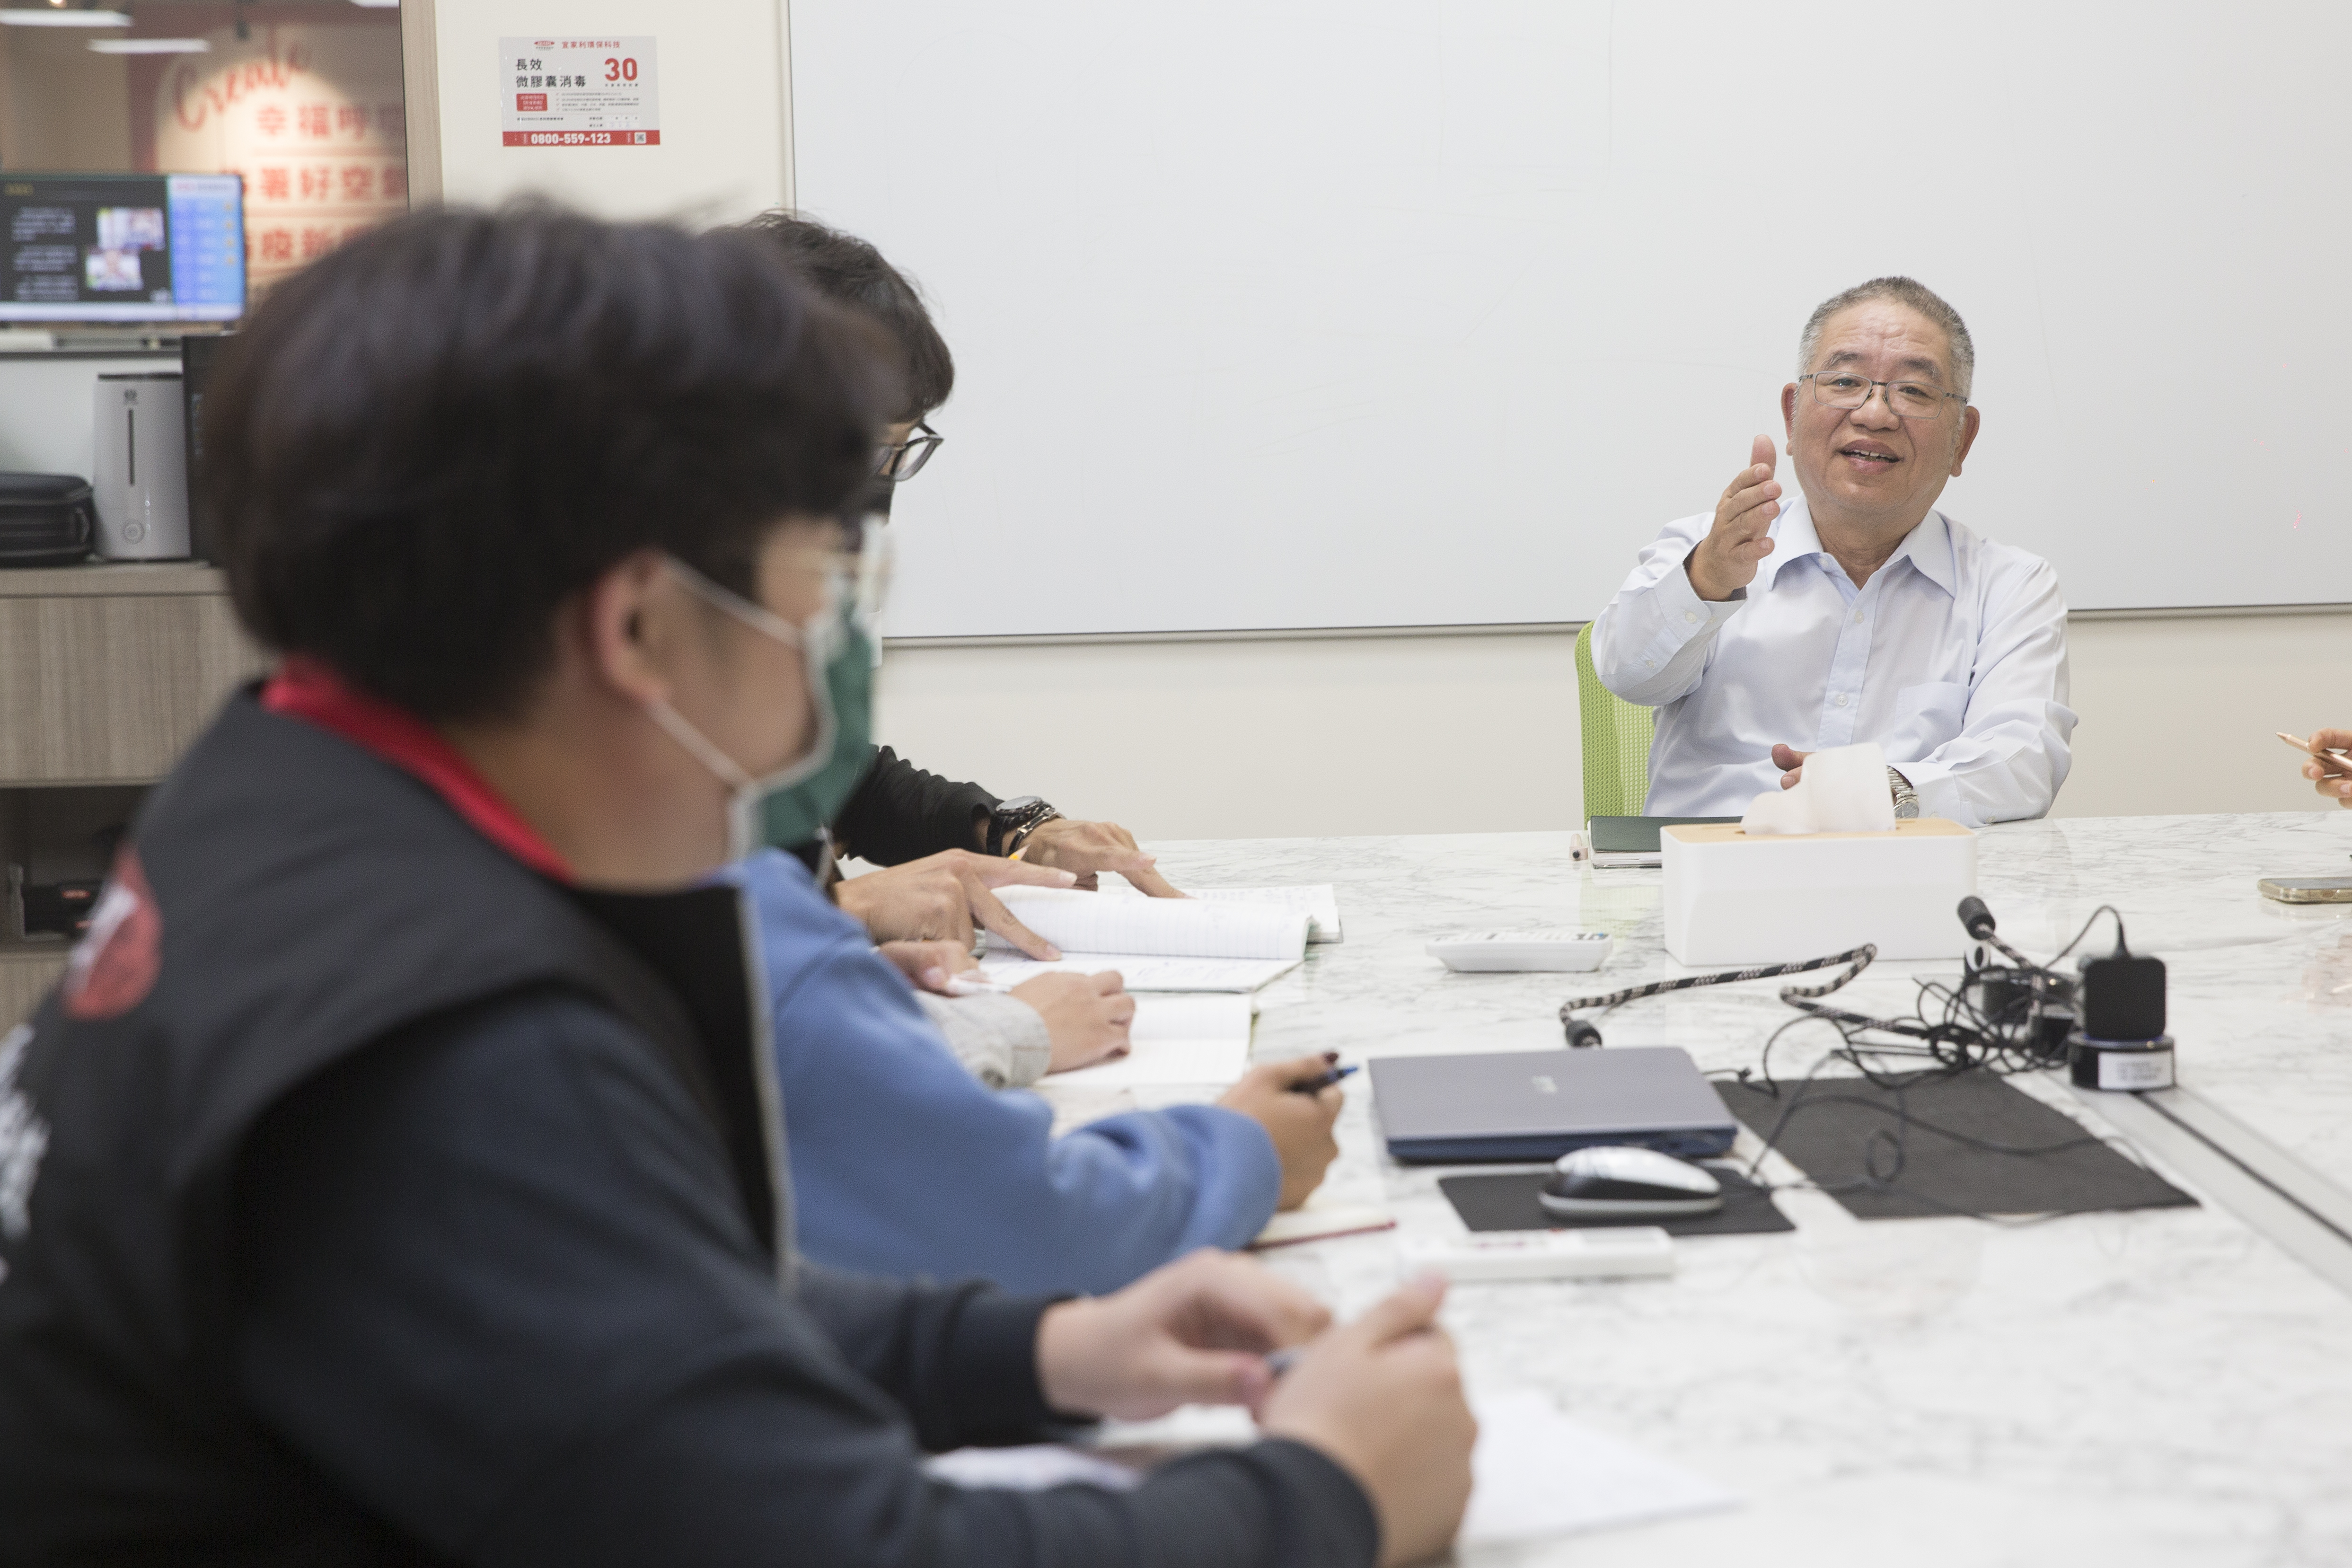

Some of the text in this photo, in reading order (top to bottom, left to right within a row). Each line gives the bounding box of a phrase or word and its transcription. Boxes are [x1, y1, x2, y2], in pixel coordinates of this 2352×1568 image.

[516, 58, 542, 70] 長效
[605, 58, 637, 81] 30
[516, 75, 586, 88] 微膠囊消毒
[531, 133, 611, 144] 0800-559-123
